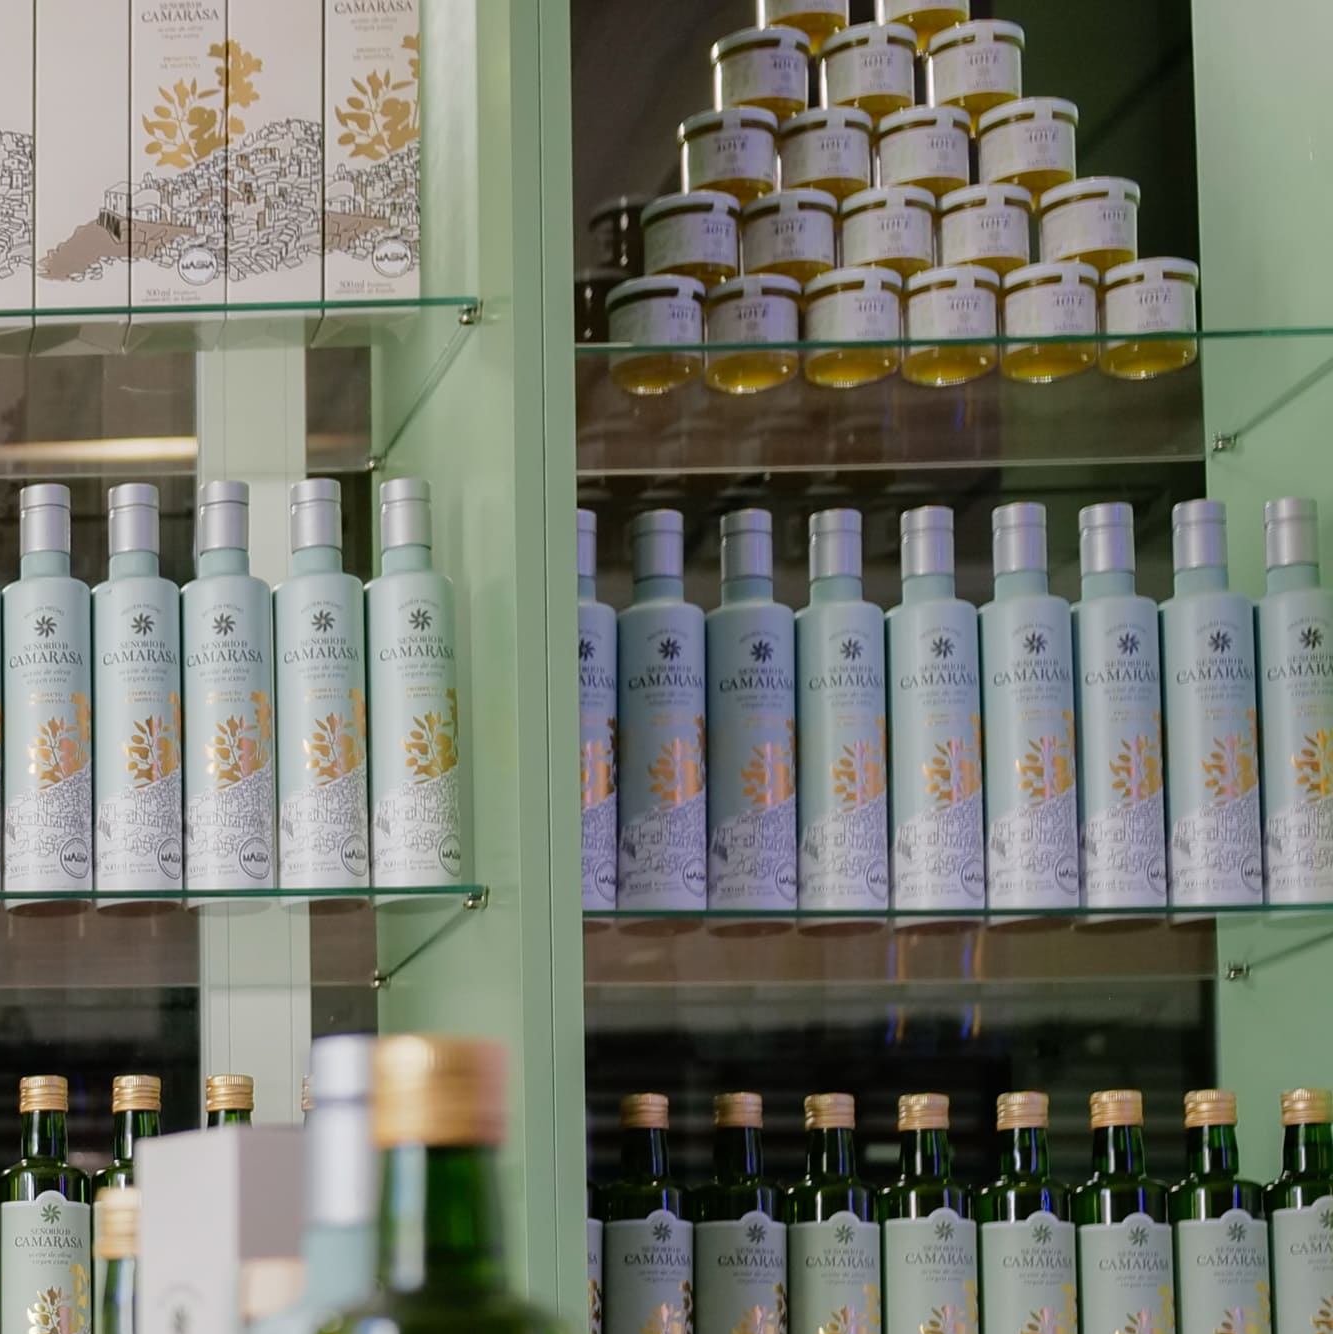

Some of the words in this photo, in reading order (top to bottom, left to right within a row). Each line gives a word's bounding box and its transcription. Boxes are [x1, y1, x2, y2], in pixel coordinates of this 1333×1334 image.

[334, 0, 413, 14] CAMARASA
[141, 8, 220, 24] CAMARASA
[9, 649, 83, 668] CAMARASA
[102, 649, 179, 667] CAMARASA
[186, 650, 263, 667] CAMARASA
[284, 646, 360, 664] CAMARASA
[14, 1235, 83, 1250] CAMARASA
